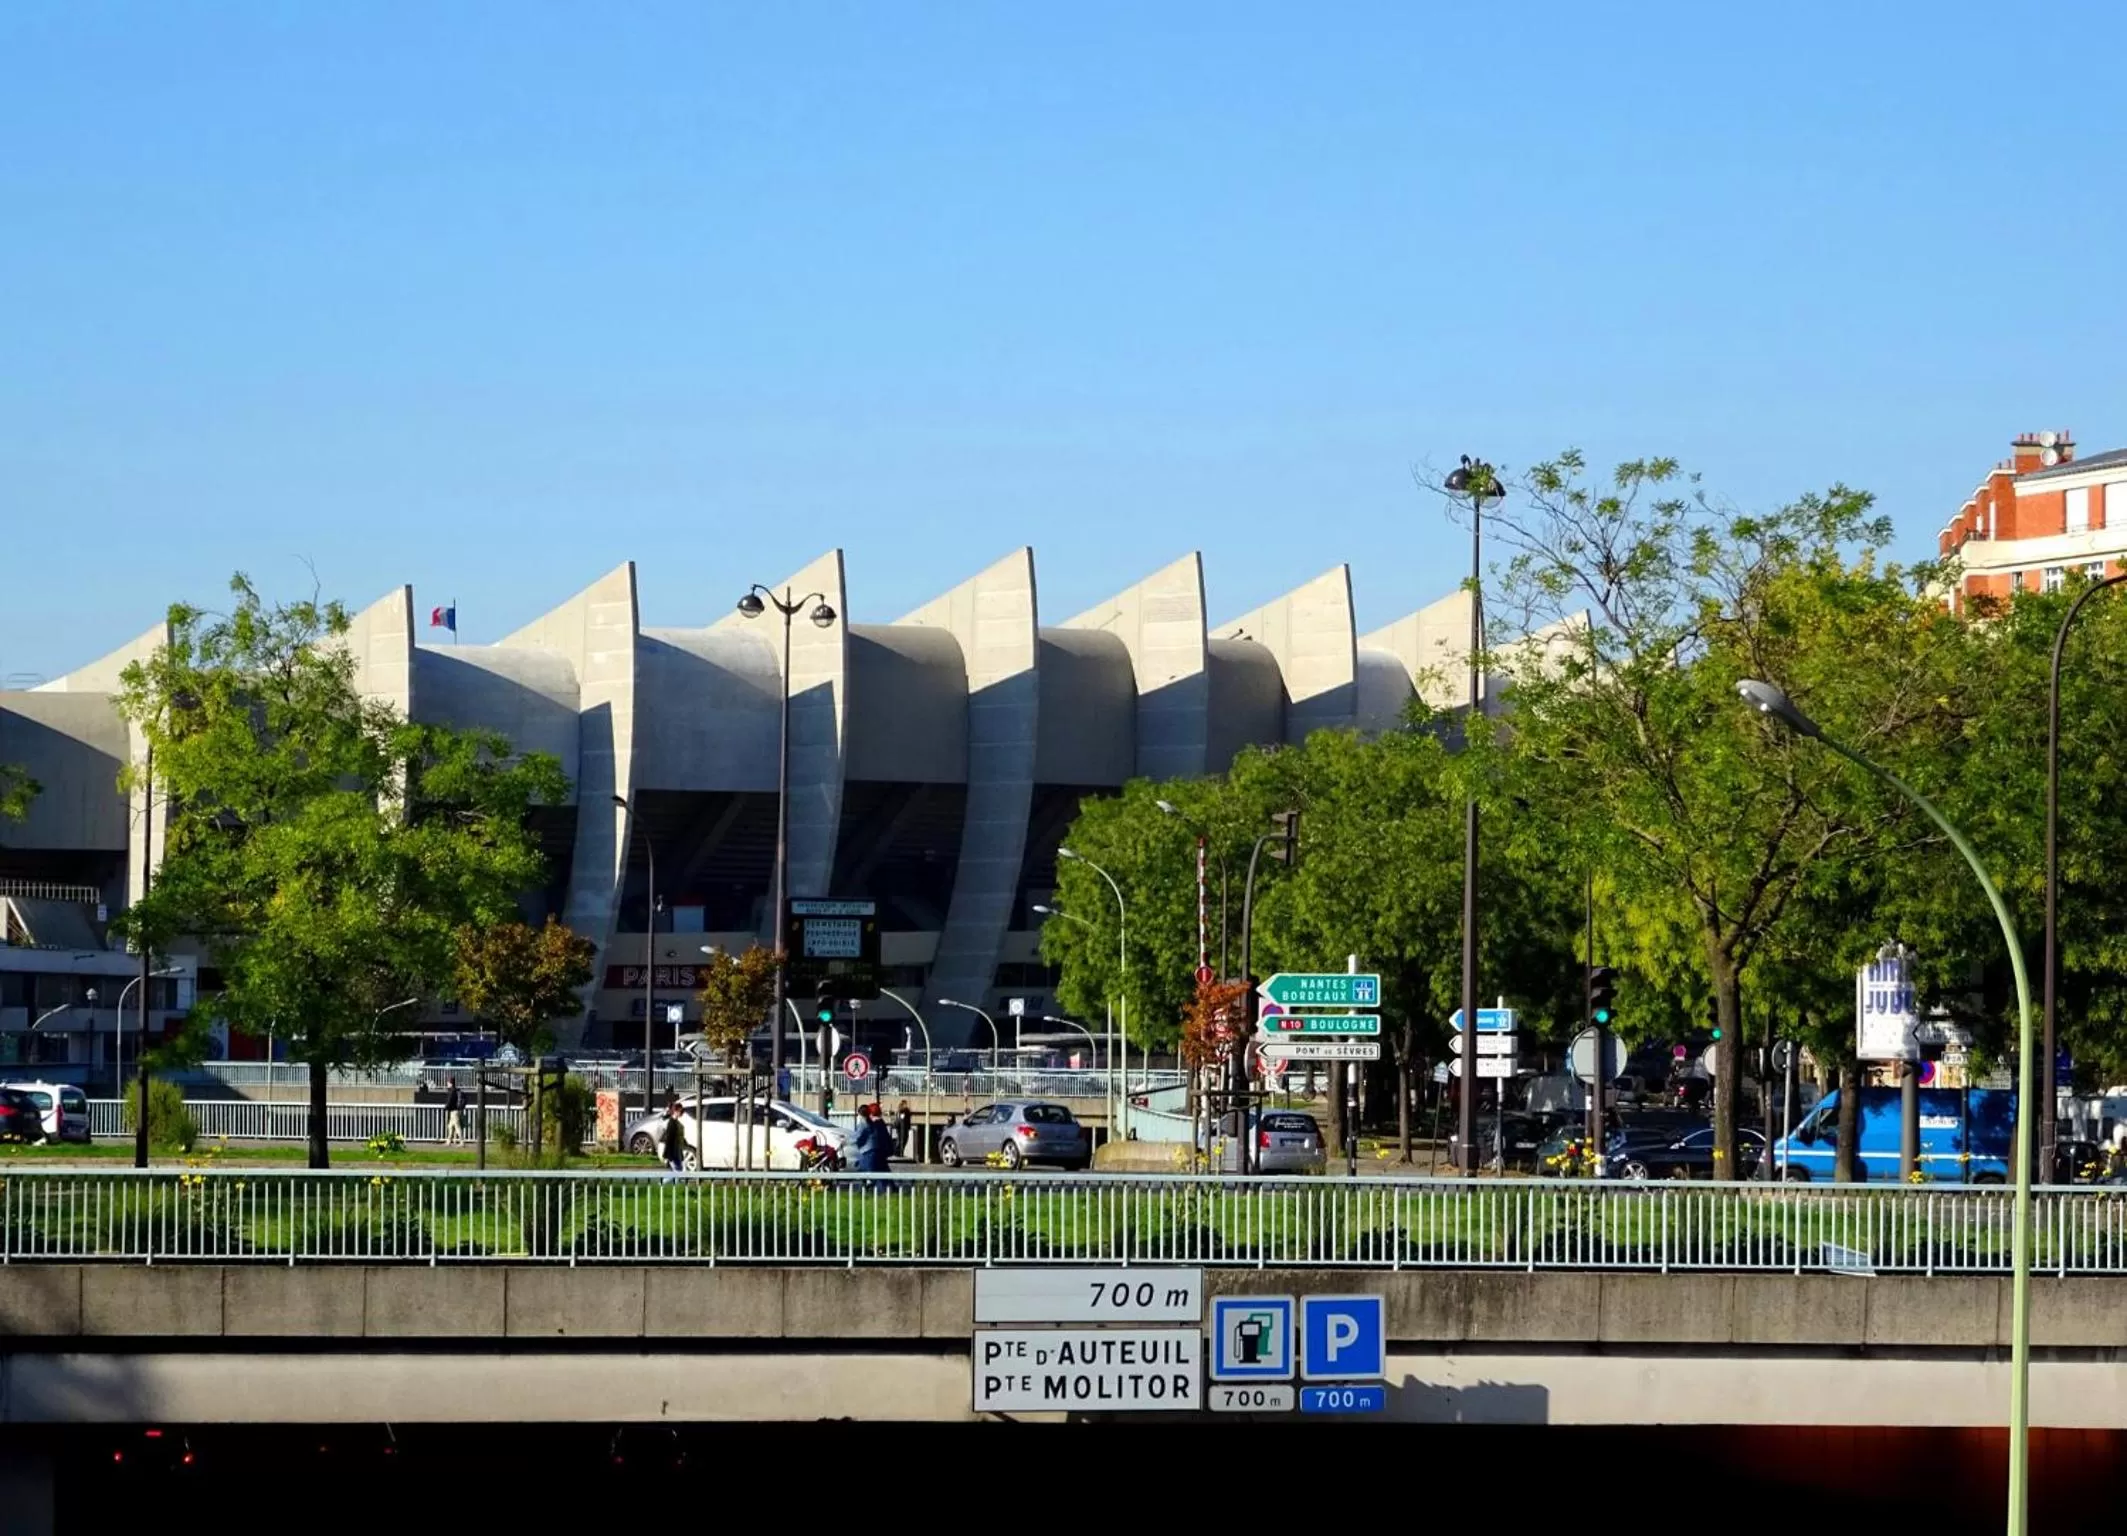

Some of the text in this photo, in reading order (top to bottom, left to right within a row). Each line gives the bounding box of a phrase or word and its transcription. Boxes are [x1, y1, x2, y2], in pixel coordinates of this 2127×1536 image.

[623, 967, 696, 986] PARIS
[1301, 979, 1347, 989] NANTES
[1282, 991, 1347, 1001] BORDEAUX
[1310, 1020, 1374, 1030] BOULOGNE
[1296, 1047, 1320, 1055] PONT
[1090, 1282, 1189, 1307] 700 m
[1326, 1314, 1360, 1362] P
[1044, 1374, 1190, 1400] MOLITOR
[1224, 1391, 1281, 1406] 700 m
[1315, 1391, 1371, 1408] 700 m
